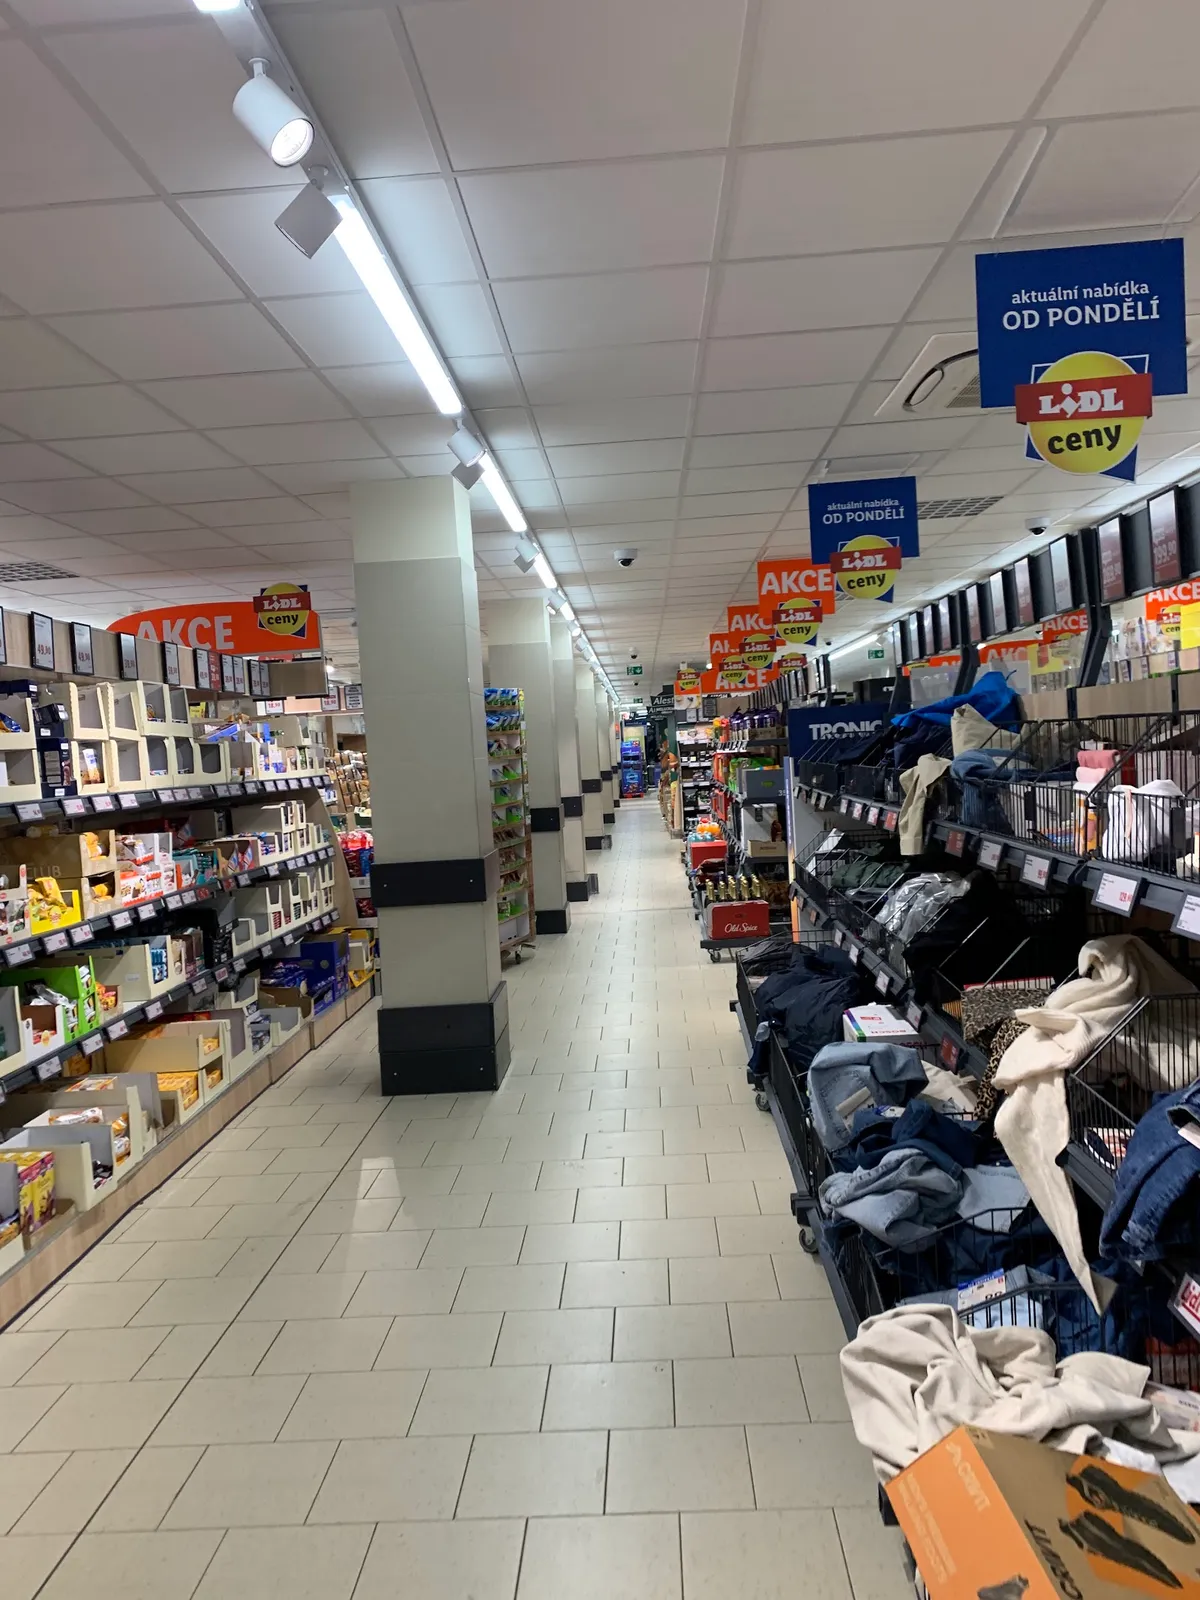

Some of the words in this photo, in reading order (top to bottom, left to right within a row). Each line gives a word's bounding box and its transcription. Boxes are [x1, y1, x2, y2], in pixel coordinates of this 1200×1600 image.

[1011, 286, 1079, 304] aktuální
[1082, 281, 1150, 299] nabídka
[1002, 310, 1040, 330] OD
[1047, 296, 1160, 327] PONDĚLÍ
[1038, 383, 1124, 418] LIDL
[1047, 424, 1122, 454] ceny
[826, 500, 863, 511] aktuální
[864, 498, 899, 509] nabídka
[822, 513, 843, 525] OD
[846, 506, 905, 523] PONDĚLÍ
[842, 552, 887, 570] LIDL
[760, 569, 833, 595] AKCE
[847, 573, 886, 590] ceny
[263, 595, 302, 611] LIDL
[267, 614, 298, 625] ceny
[730, 613, 777, 631] AKC
[780, 609, 814, 622] LIDL
[1043, 614, 1088, 631] AKCE
[136, 615, 235, 650] AKCE
[783, 625, 812, 635] ceny
[744, 643, 770, 652] LIDL
[747, 654, 769, 662] ceny
[724, 923, 740, 934] Old
[740, 922, 758, 933] Spice
